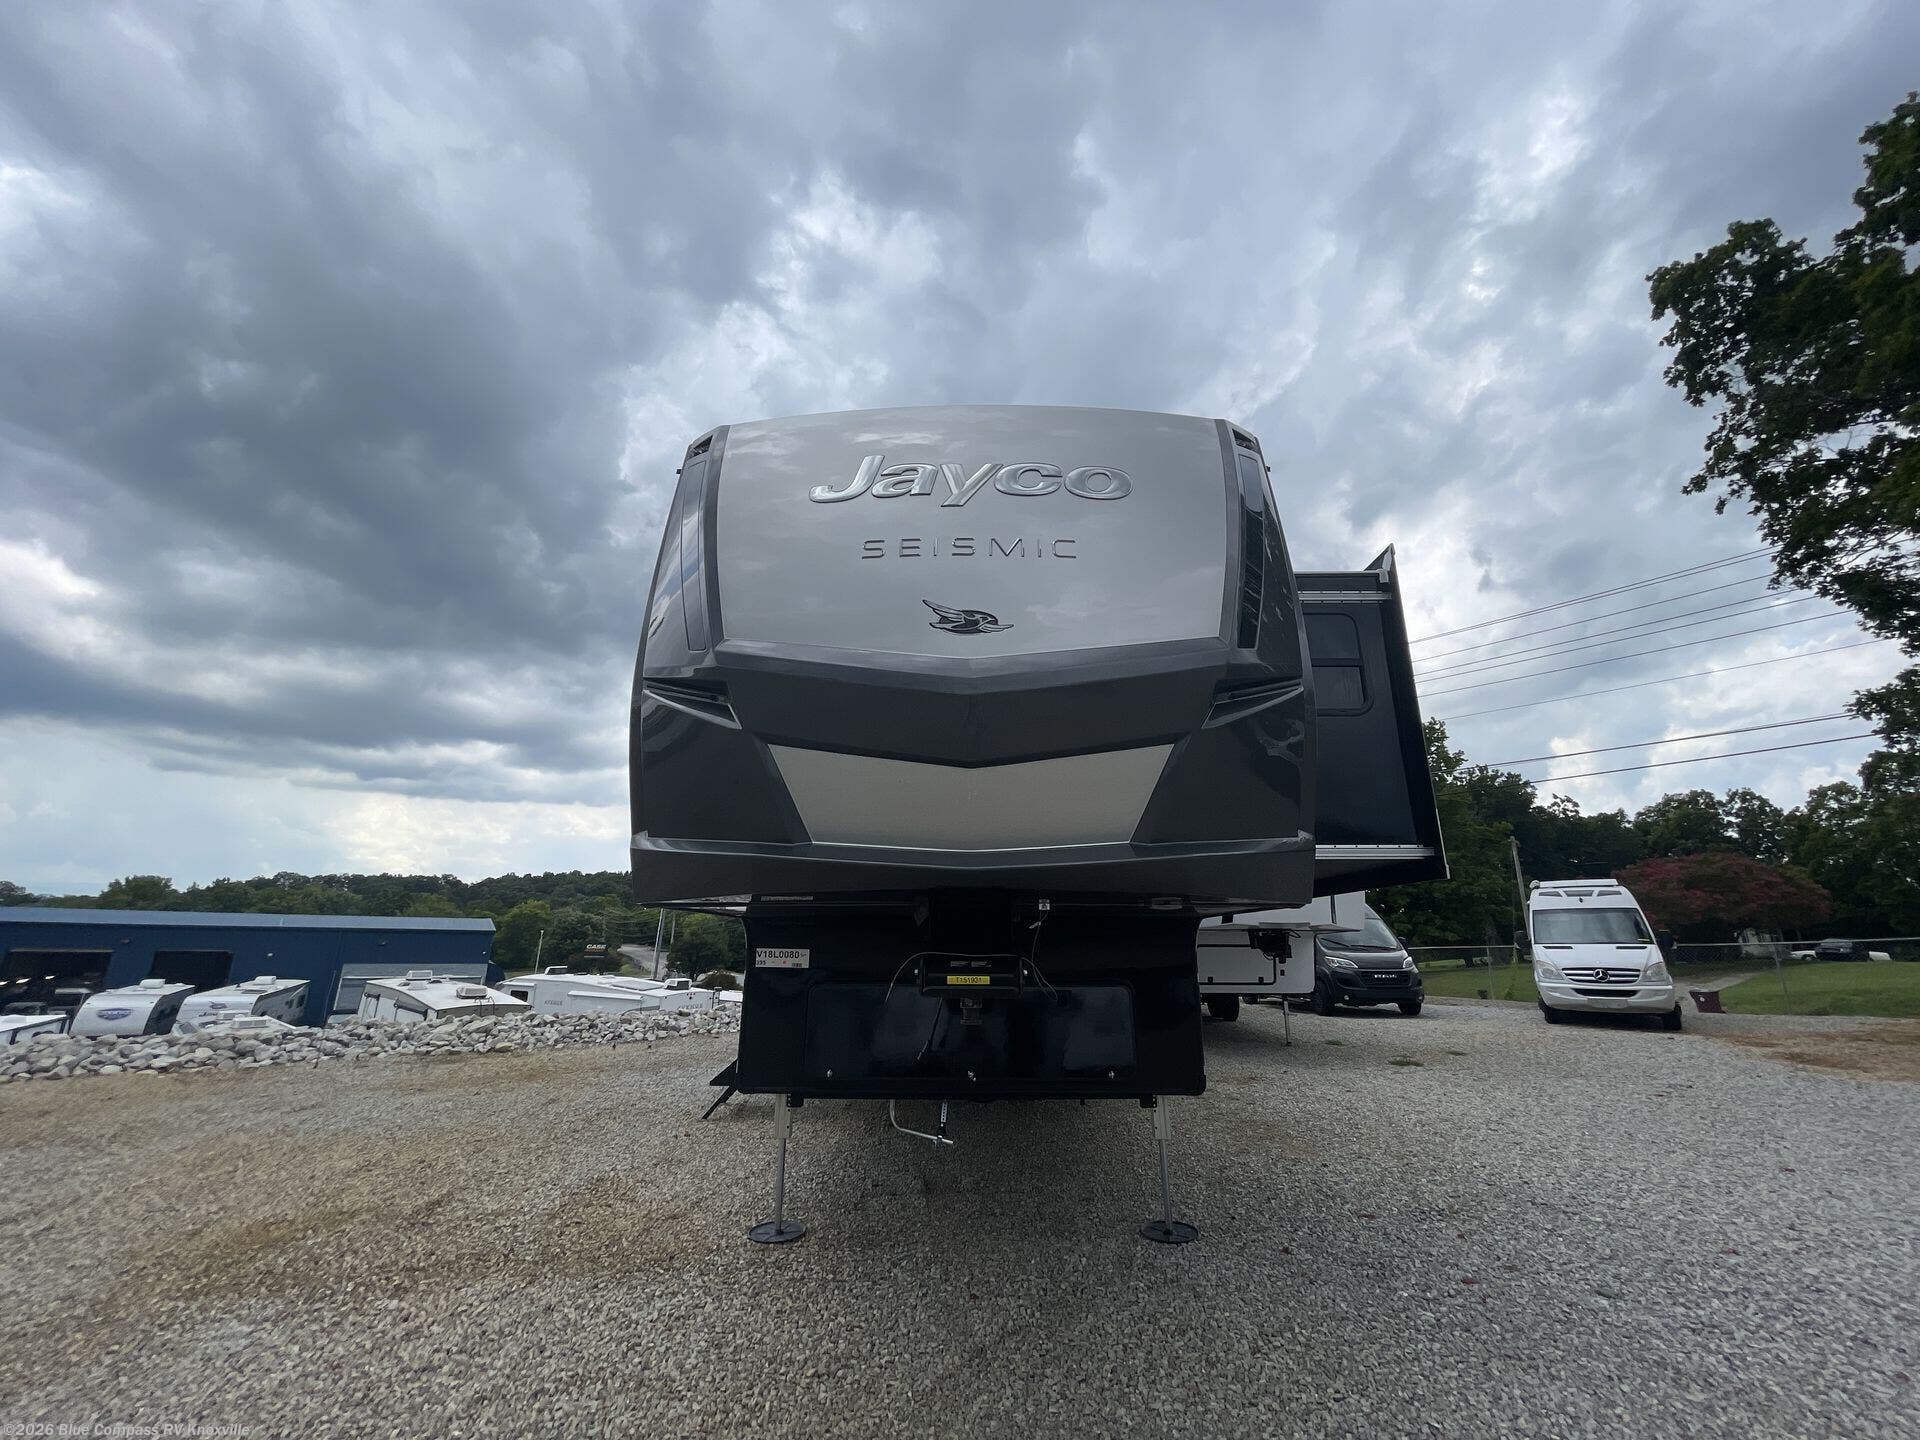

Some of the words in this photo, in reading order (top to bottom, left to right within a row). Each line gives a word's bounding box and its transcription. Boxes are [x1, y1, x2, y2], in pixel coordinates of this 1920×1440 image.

[808, 455, 1134, 507] Jayco
[861, 537, 1077, 559] SEISMIC
[756, 950, 800, 959] V18L0080
